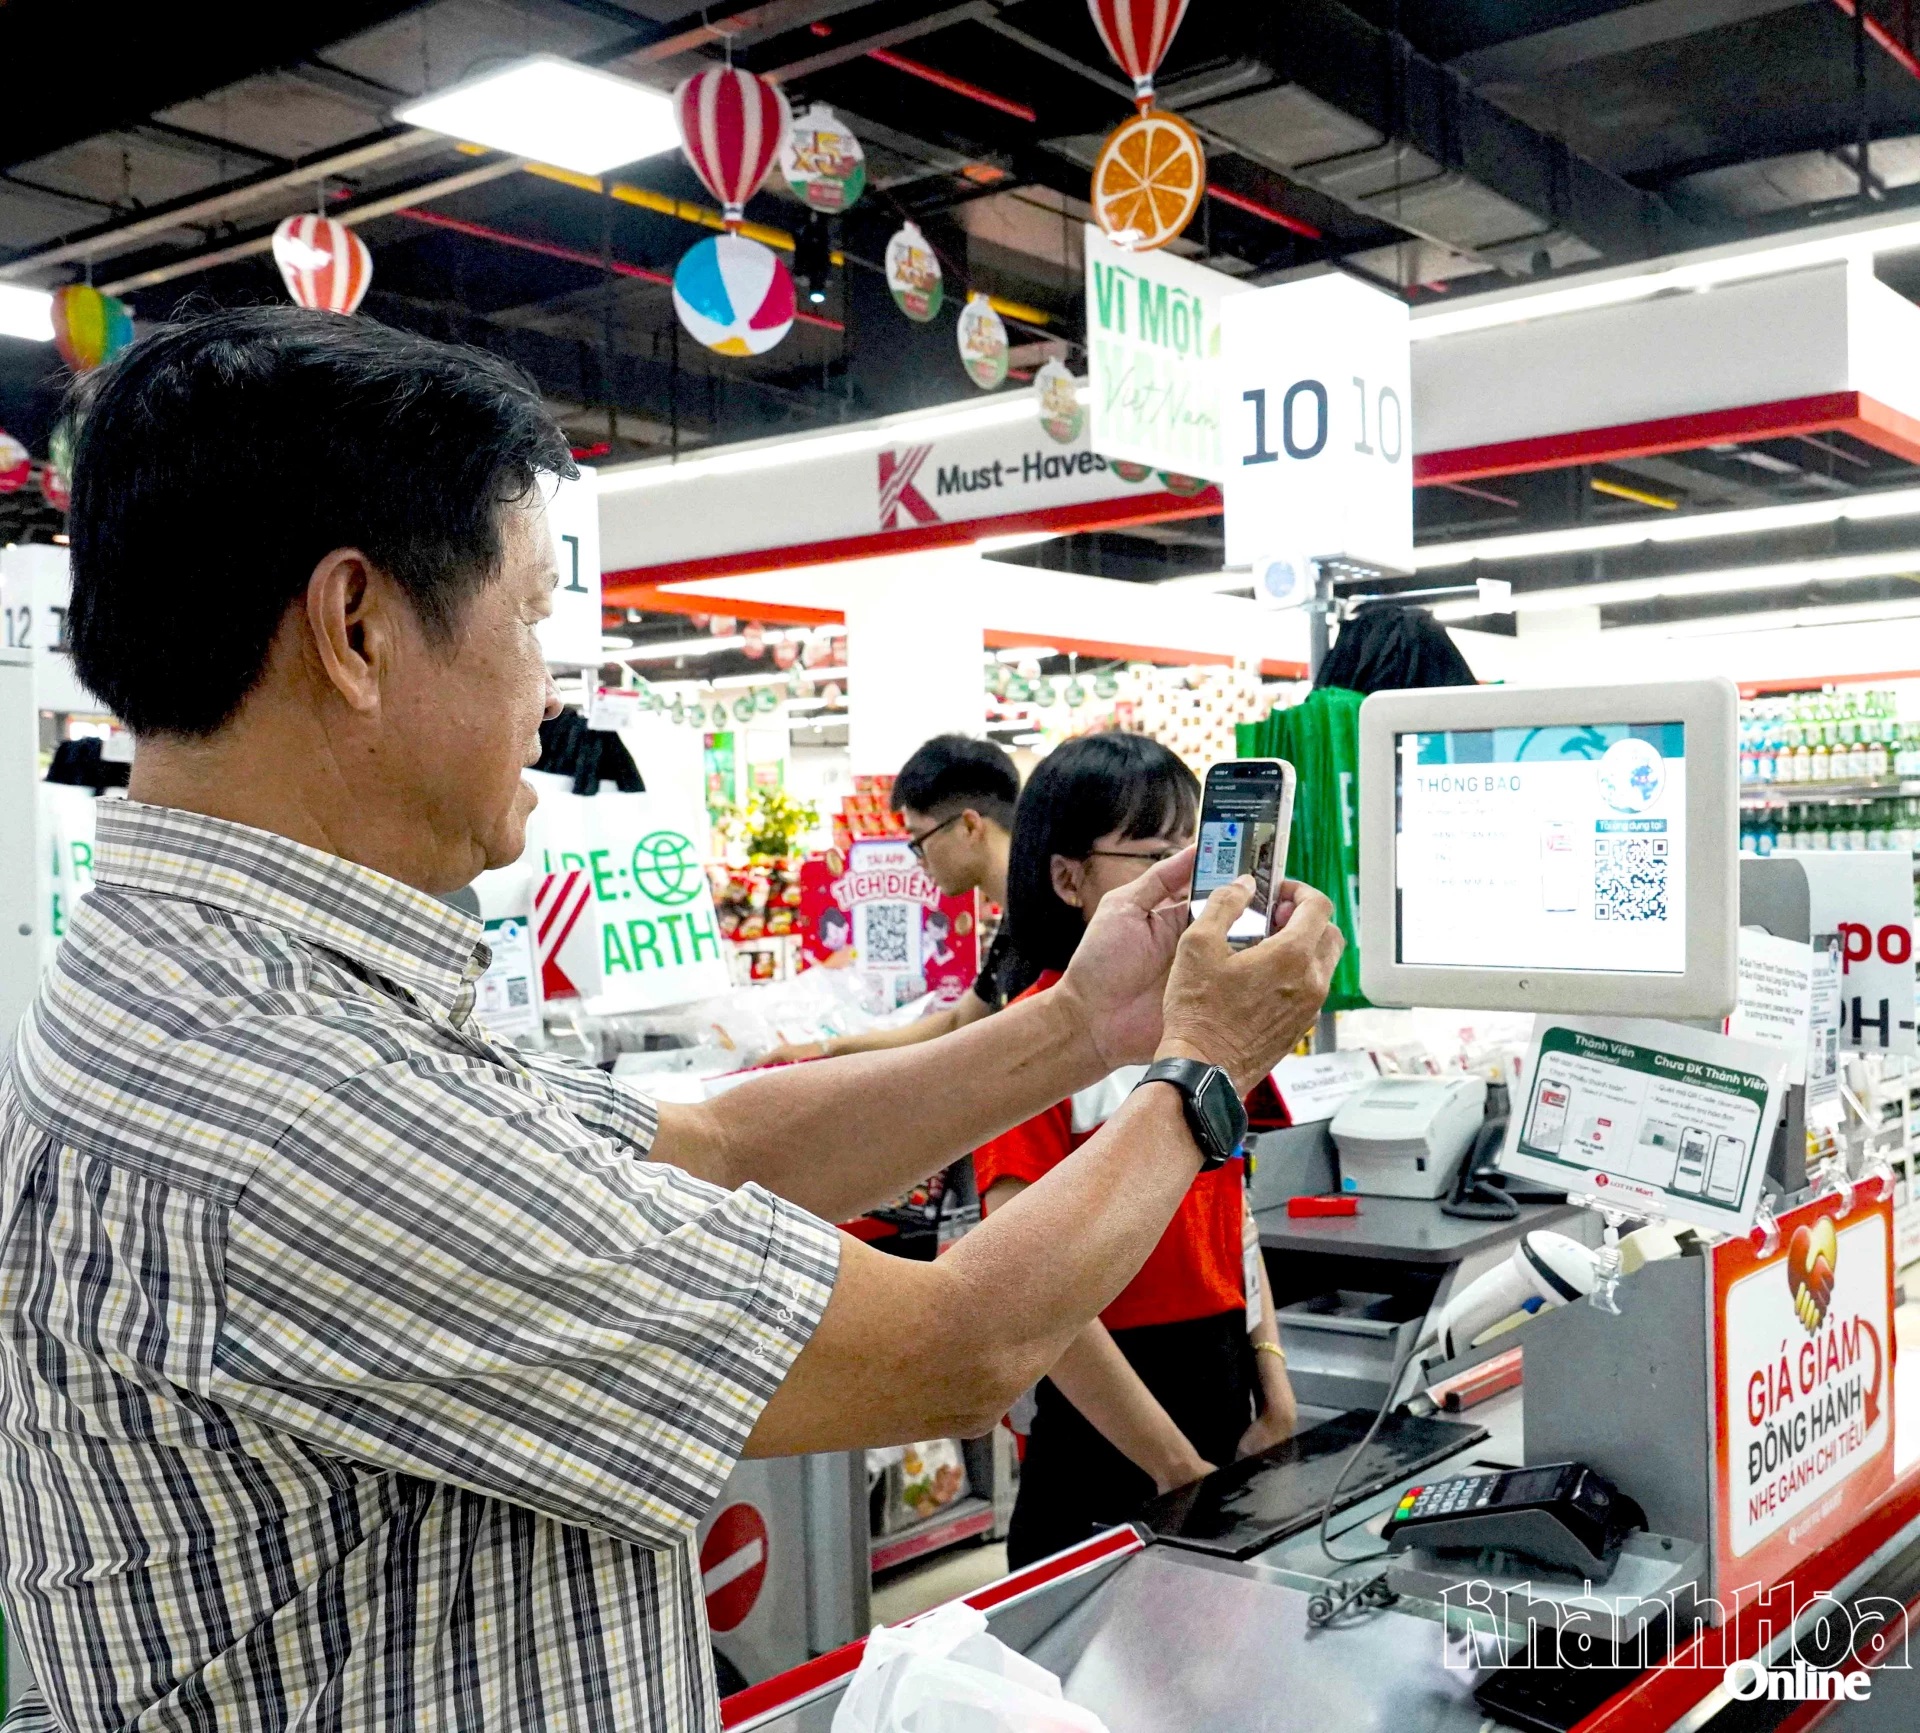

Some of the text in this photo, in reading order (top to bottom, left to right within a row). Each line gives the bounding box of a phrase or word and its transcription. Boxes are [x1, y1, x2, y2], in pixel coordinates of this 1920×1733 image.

[1093, 261, 1136, 334] Vì
[1138, 278, 1204, 360] Một
[1242, 378, 1329, 466] 10
[1353, 376, 1402, 464] 10
[937, 450, 1108, 496] Must-Haves
[837, 874, 881, 901] TÍCH
[1575, 1034, 1635, 1058] Thành Viên
[1654, 1054, 1768, 1092] Chưa ĐK Thành Viên
[1748, 1312, 1861, 1427] GIÁ GIẢM
[1748, 1374, 1861, 1486] ĐỒNG HÀNH
[1749, 1482, 1776, 1526] NHẸ
[1778, 1455, 1815, 1503] GÁNH
[1816, 1438, 1837, 1475] CHI
